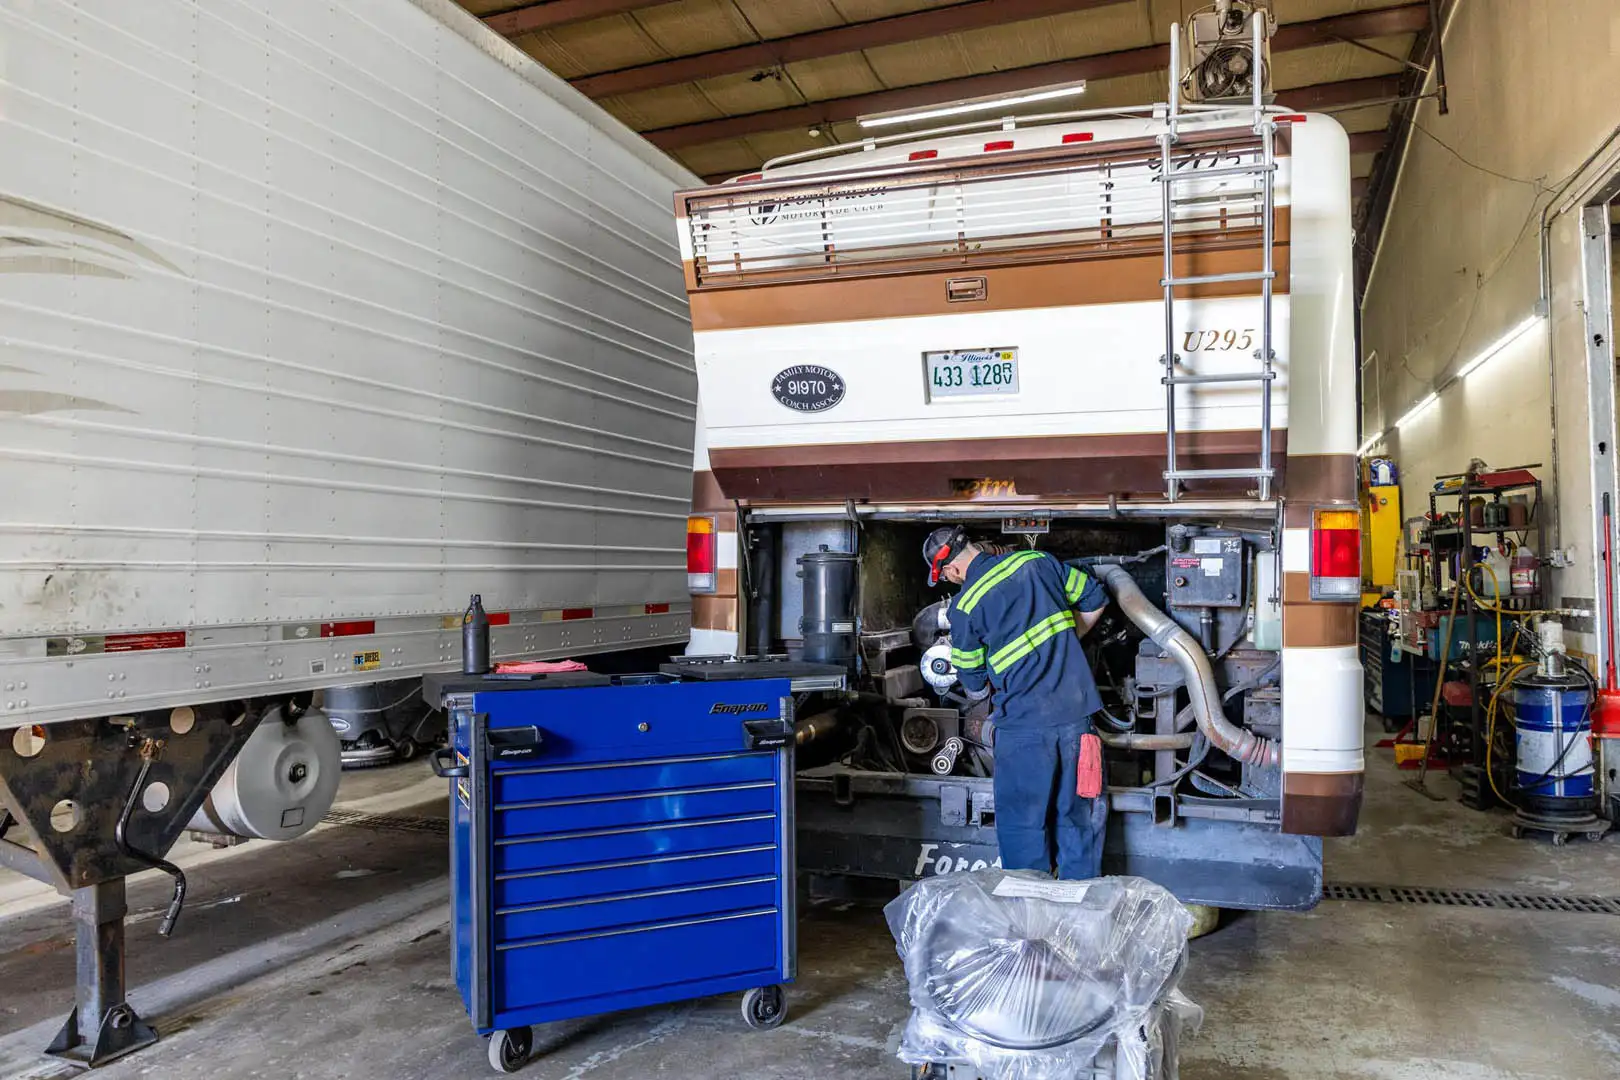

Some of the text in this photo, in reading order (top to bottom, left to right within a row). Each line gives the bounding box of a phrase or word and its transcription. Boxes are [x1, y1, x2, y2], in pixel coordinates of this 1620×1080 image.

[1183, 328, 1255, 353] U295
[775, 365, 837, 384] FAMILY MOTOR
[933, 365, 963, 387] 433
[788, 380, 826, 395] 91970
[780, 395, 809, 410] COACH
